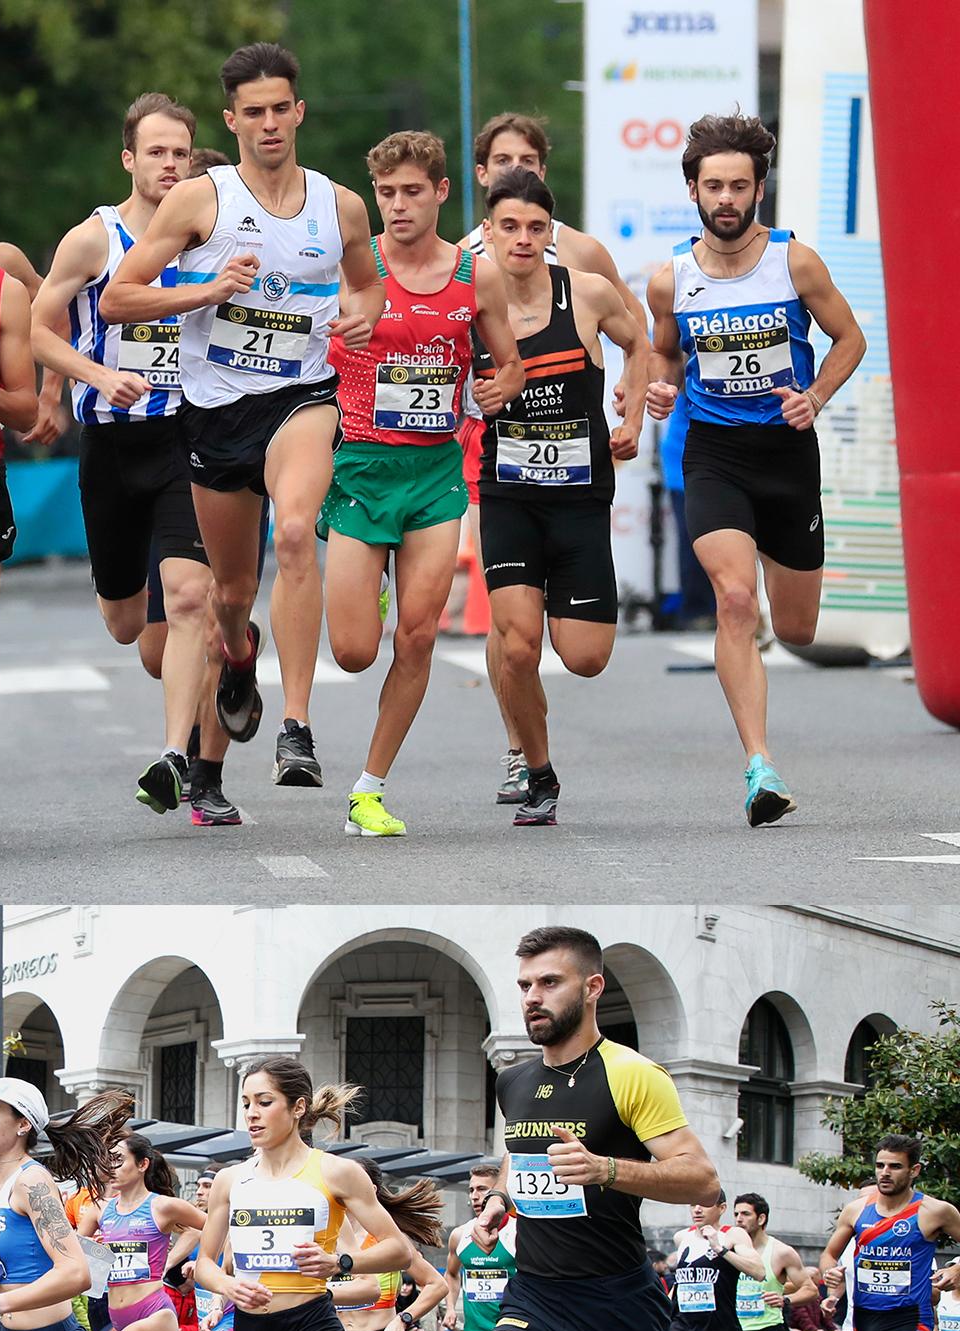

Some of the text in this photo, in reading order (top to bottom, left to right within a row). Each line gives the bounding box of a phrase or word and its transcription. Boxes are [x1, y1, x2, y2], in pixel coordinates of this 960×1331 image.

[622, 120, 684, 150] GO
[255, 311, 303, 323] RUNNING
[265, 321, 293, 331] LOOP
[243, 330, 274, 354] 21
[729, 330, 777, 342] RUNNING
[415, 343, 445, 354] Patria
[742, 341, 771, 350] LOOP
[151, 346, 180, 368] 24
[229, 351, 282, 373] Joma
[728, 353, 761, 376] 26
[143, 371, 180, 385] Jom
[415, 368, 452, 376] RUNNI
[521, 383, 565, 401] VICKY
[722, 376, 775, 394] Joma
[409, 387, 441, 411] 23
[525, 396, 563, 410] FOODS
[527, 408, 564, 418] ATHLETICS
[397, 413, 448, 428] Joma
[530, 422, 578, 432] RUNNING
[543, 432, 571, 440] LOOP
[528, 443, 559, 465] 20
[519, 467, 570, 481] Joma
[2, 953, 59, 986] ORREOS
[515, 1172, 569, 1195] 1325
[256, 1209, 304, 1217] RUNNING
[268, 1217, 296, 1226] LOOP
[261, 1229, 275, 1251] 3
[876, 1246, 889, 1257] DE
[112, 1254, 133, 1269] 17
[245, 1254, 294, 1270] Joma
[110, 1269, 137, 1280] Joma
[872, 1272, 891, 1284] 53
[477, 1280, 492, 1291] 55
[866, 1284, 897, 1293] Joma
